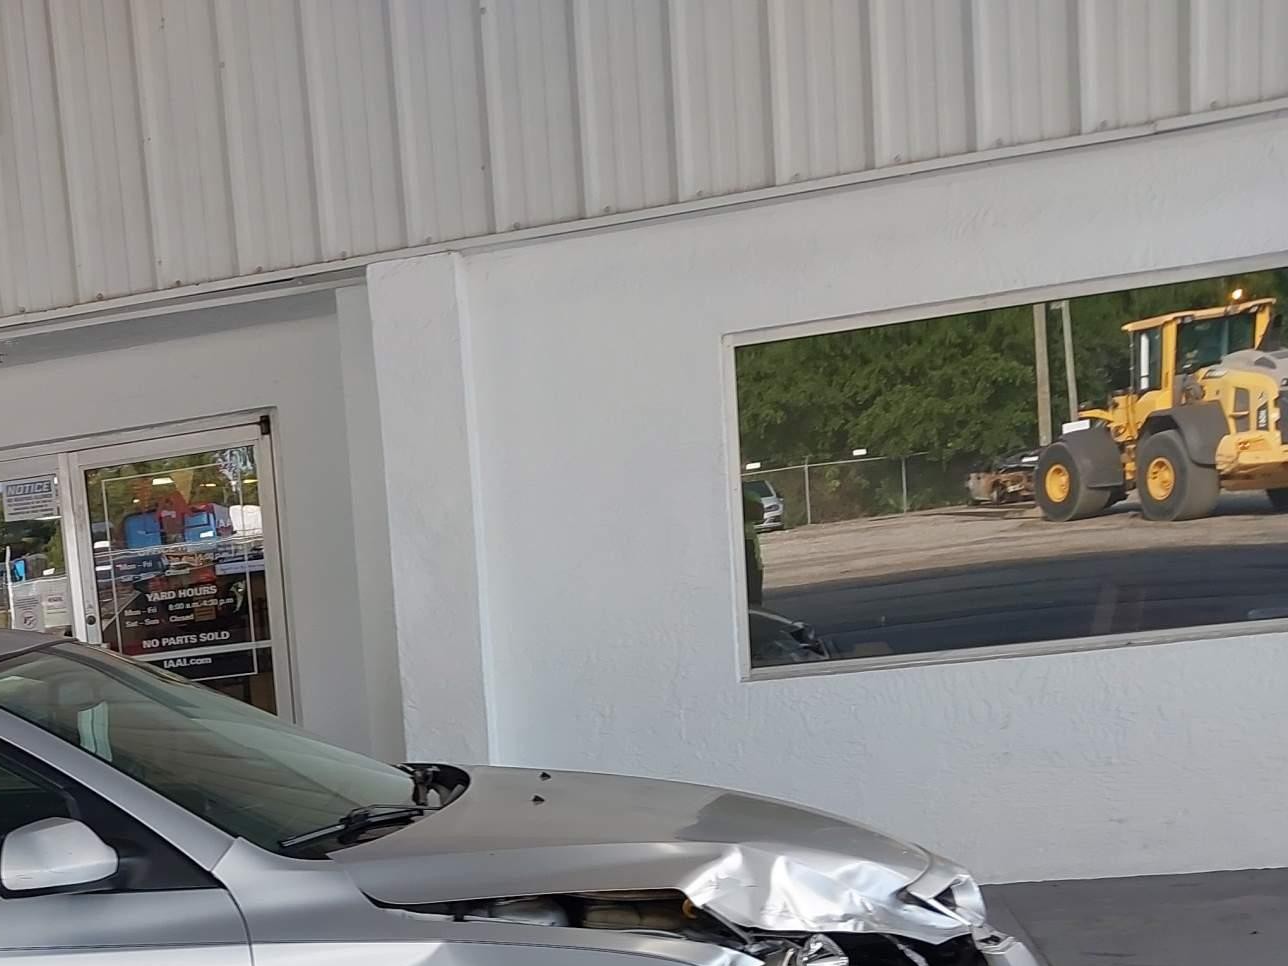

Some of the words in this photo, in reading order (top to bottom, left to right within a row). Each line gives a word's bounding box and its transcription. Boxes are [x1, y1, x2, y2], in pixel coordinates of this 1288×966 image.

[7, 481, 51, 496] NOTICE
[146, 590, 177, 602] YARD
[178, 585, 217, 598] HOURS
[124, 609, 141, 617] Mon
[147, 606, 157, 614] Fri
[142, 638, 160, 649] NO
[161, 634, 198, 647] PARTS
[199, 631, 230, 642] SOLD
[163, 658, 212, 668] IAAI.com
